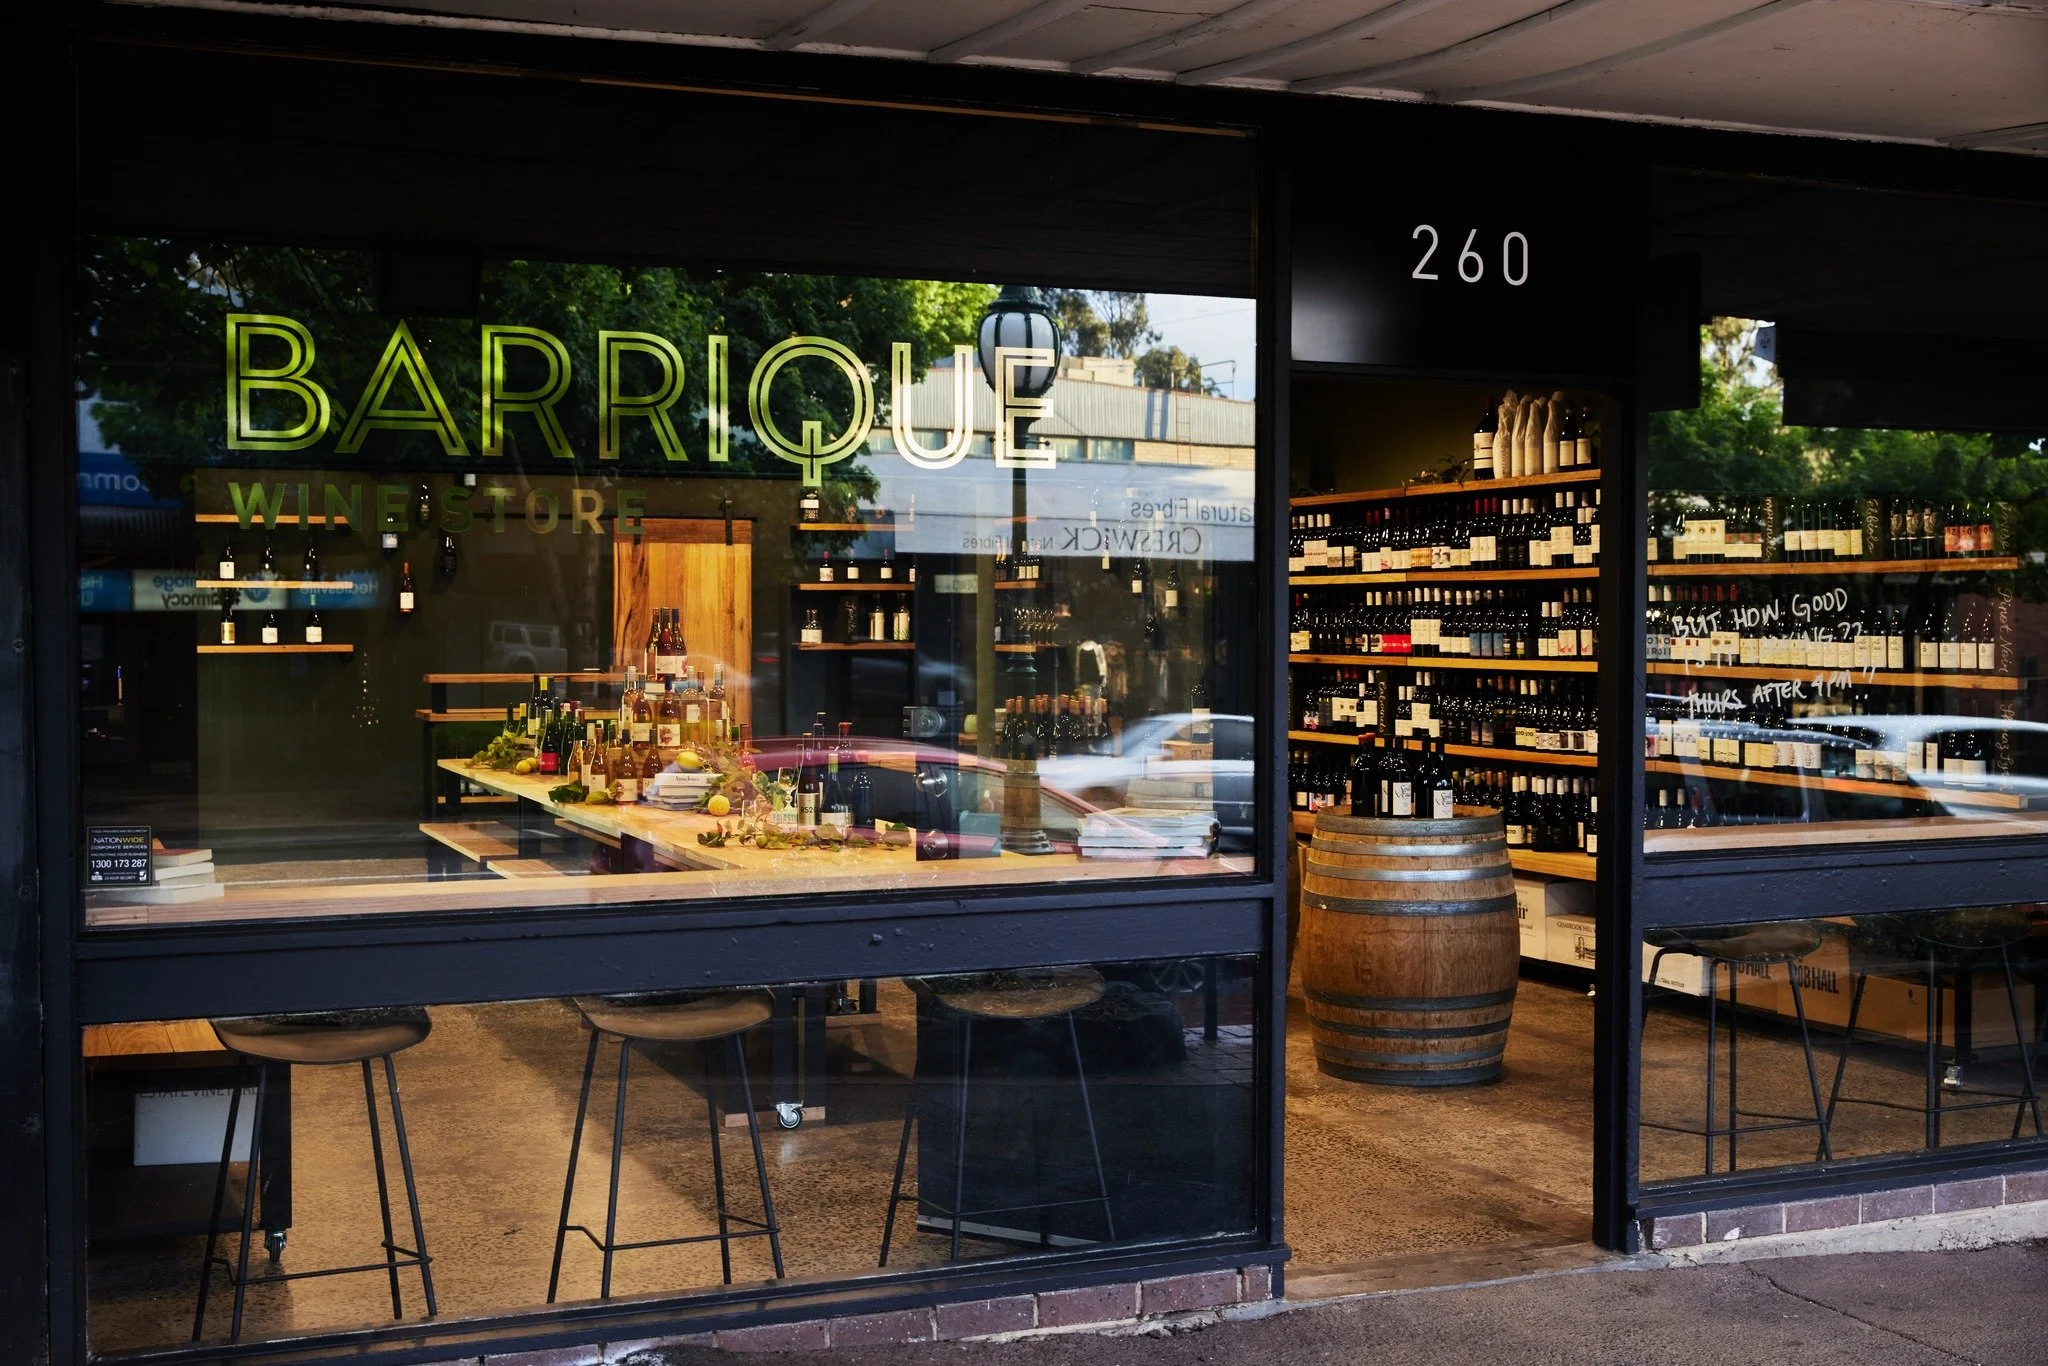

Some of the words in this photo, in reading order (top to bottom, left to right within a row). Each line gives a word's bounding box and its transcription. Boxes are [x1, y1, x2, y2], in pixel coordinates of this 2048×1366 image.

[1411, 224, 1530, 287] 260
[226, 312, 1057, 488] BARRIQUE
[227, 481, 411, 533] WINE
[438, 485, 648, 536] STORE
[1671, 610, 1722, 638] BUT
[1732, 599, 1780, 630] HOW
[1791, 587, 1849, 623] GOOD
[1752, 678, 1807, 707] AFTER
[91, 859, 112, 868] 1300
[114, 859, 130, 868] 173
[131, 858, 148, 868] 287
[93, 836, 145, 844] NATIONWIDE
